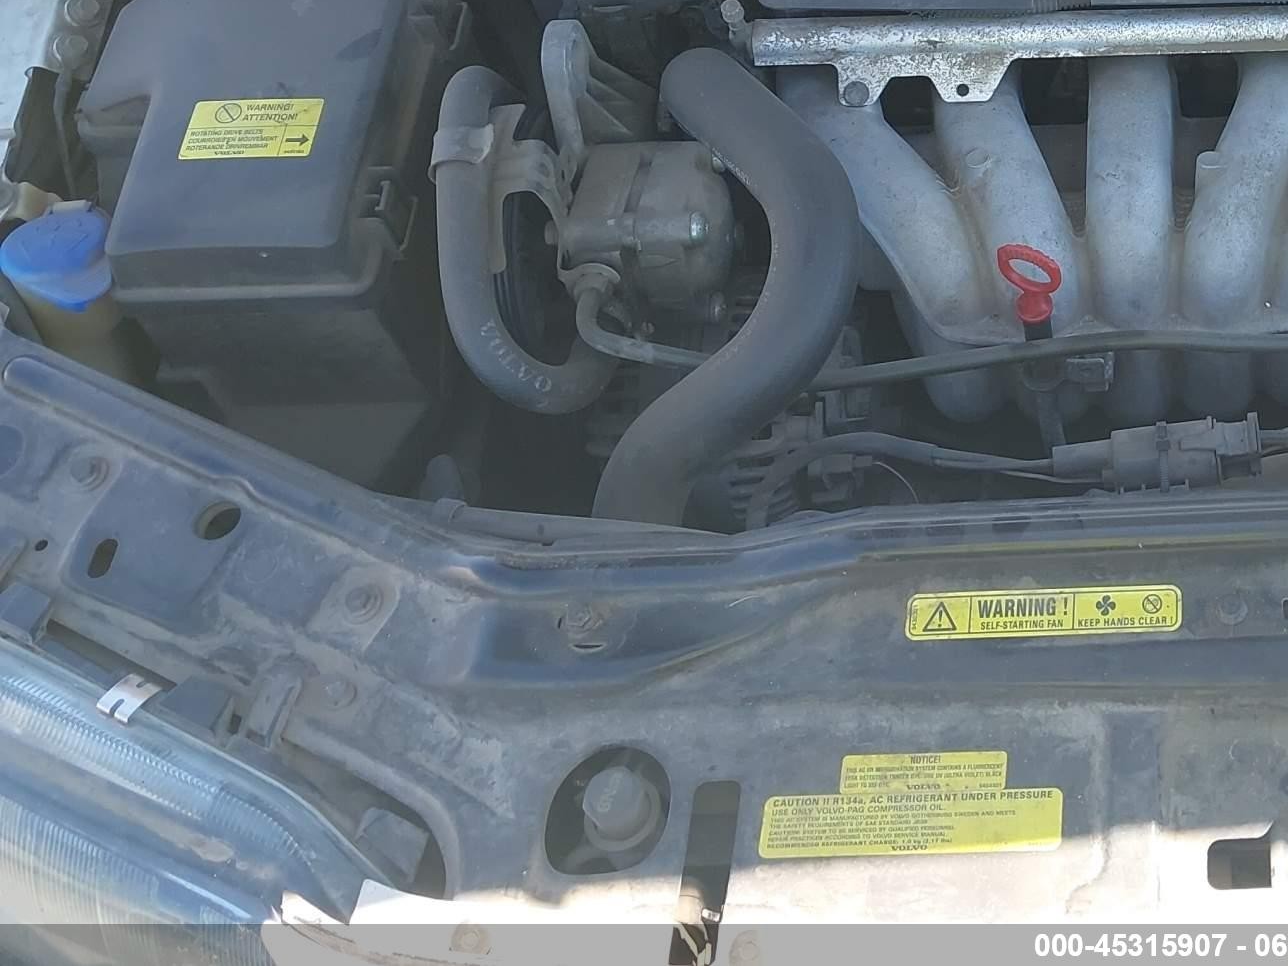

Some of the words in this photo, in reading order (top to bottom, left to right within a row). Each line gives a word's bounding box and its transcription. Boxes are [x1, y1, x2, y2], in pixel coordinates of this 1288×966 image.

[246, 104, 294, 112] WARNING!
[242, 113, 298, 122] ATTENTION!
[978, 597, 1056, 618] WARNING
[1064, 597, 1068, 616] !
[980, 620, 1044, 630] SELF-STARTING
[1048, 619, 1063, 628] FAN
[1078, 618, 1100, 627] KEEP
[1104, 617, 1135, 626] HANDS
[1138, 616, 1167, 625] CLEAR
[911, 755, 941, 764] NOTICE!
[773, 798, 819, 807] CAUTION
[833, 797, 866, 805] R134a,
[869, 796, 883, 804] AC
[887, 794, 957, 803] REFRIGERANT
[961, 792, 996, 801] UNDER
[1000, 790, 1053, 800] PRESSURE
[868, 805, 927, 813] COMPRESSOR
